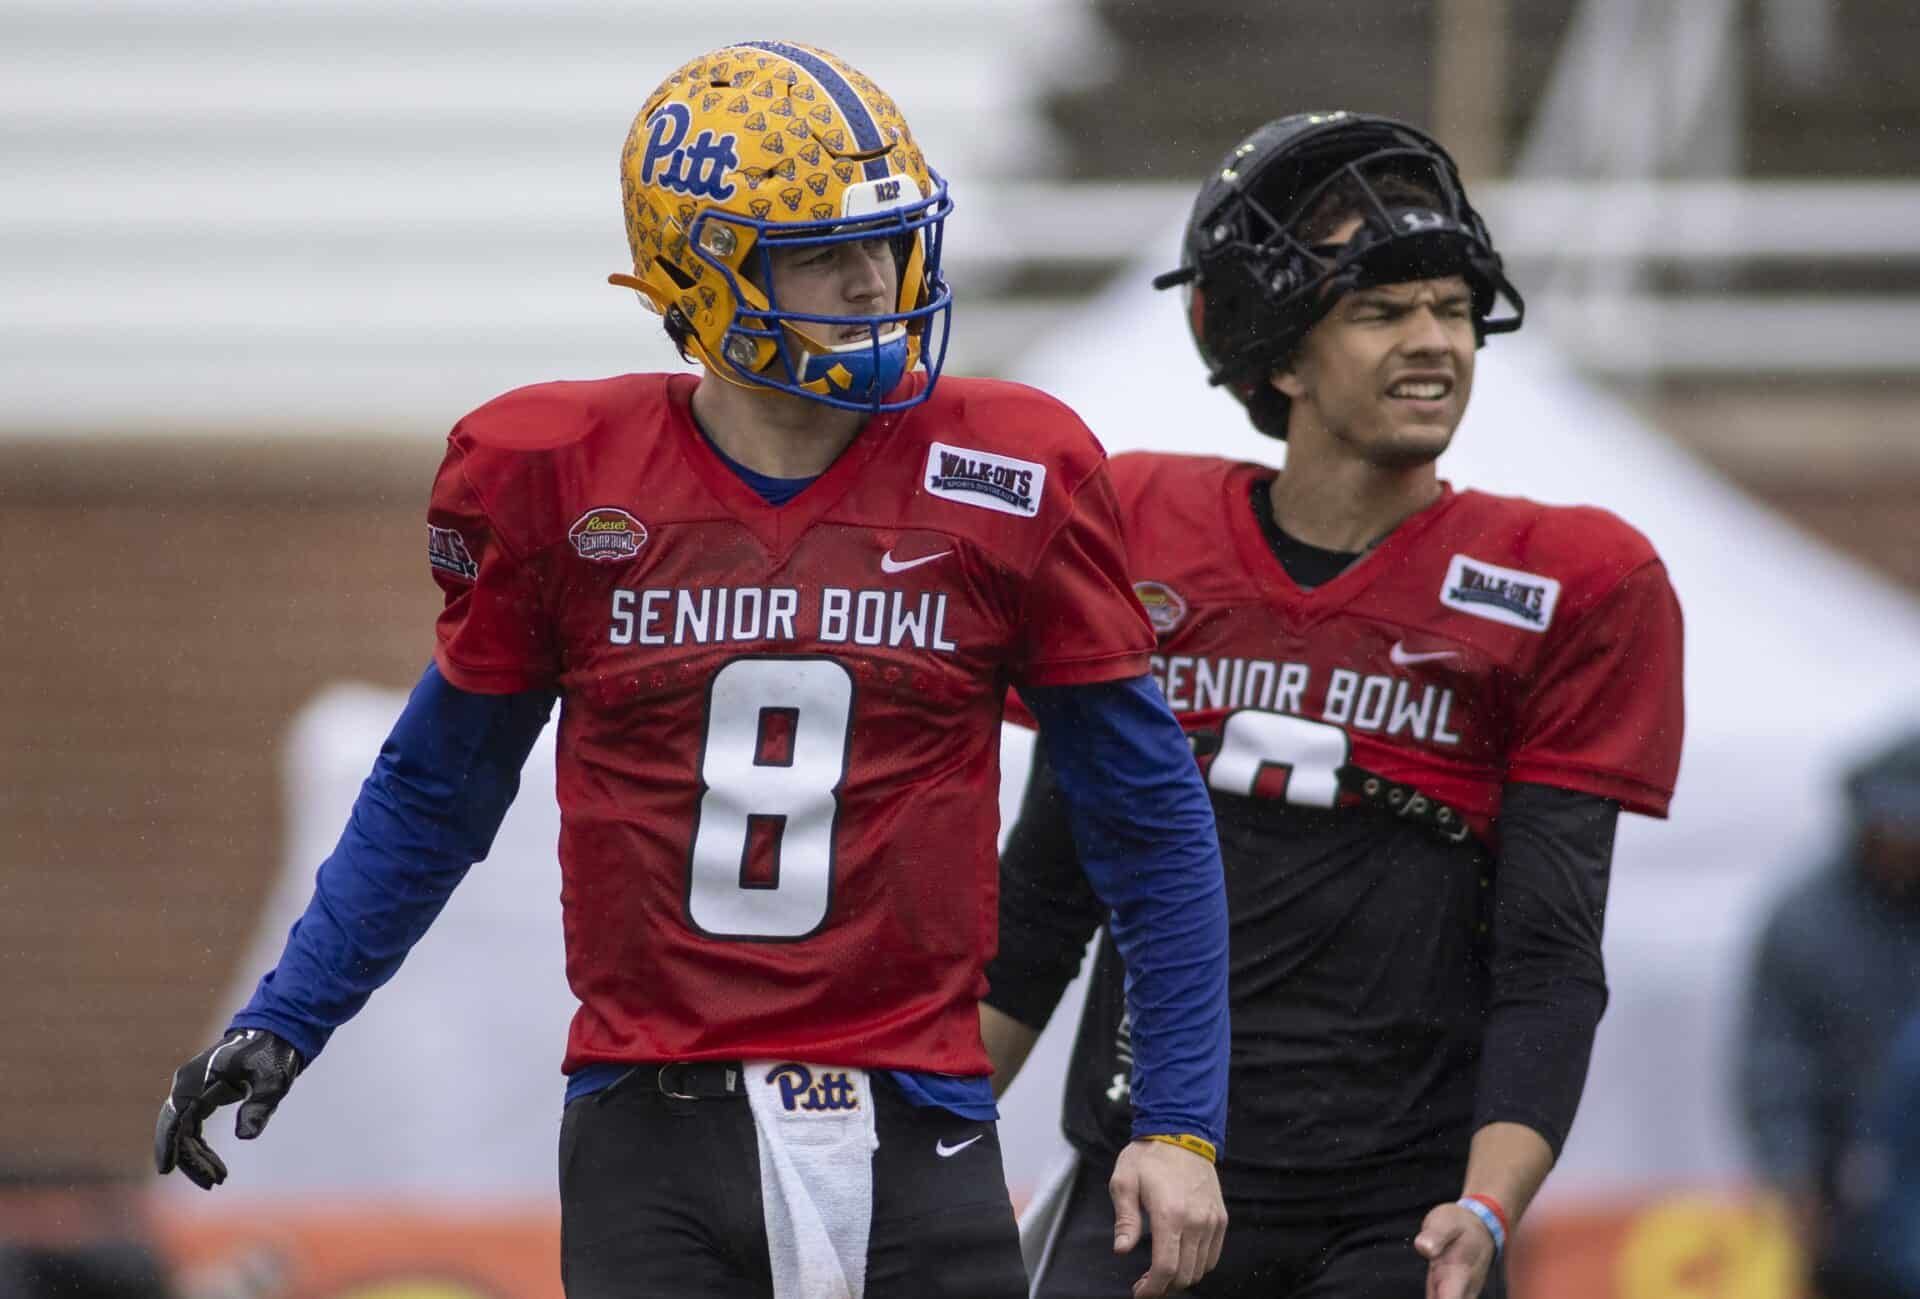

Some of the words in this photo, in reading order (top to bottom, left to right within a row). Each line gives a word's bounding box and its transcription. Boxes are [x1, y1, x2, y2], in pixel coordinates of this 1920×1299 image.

[640, 102, 739, 202] Pitt
[875, 180, 900, 202] H2P
[609, 587, 798, 645] SENIOR
[819, 587, 956, 651] BOWL
[1322, 667, 1460, 744] BOWL
[687, 656, 854, 941] 8
[765, 1062, 859, 1112] Pitt
